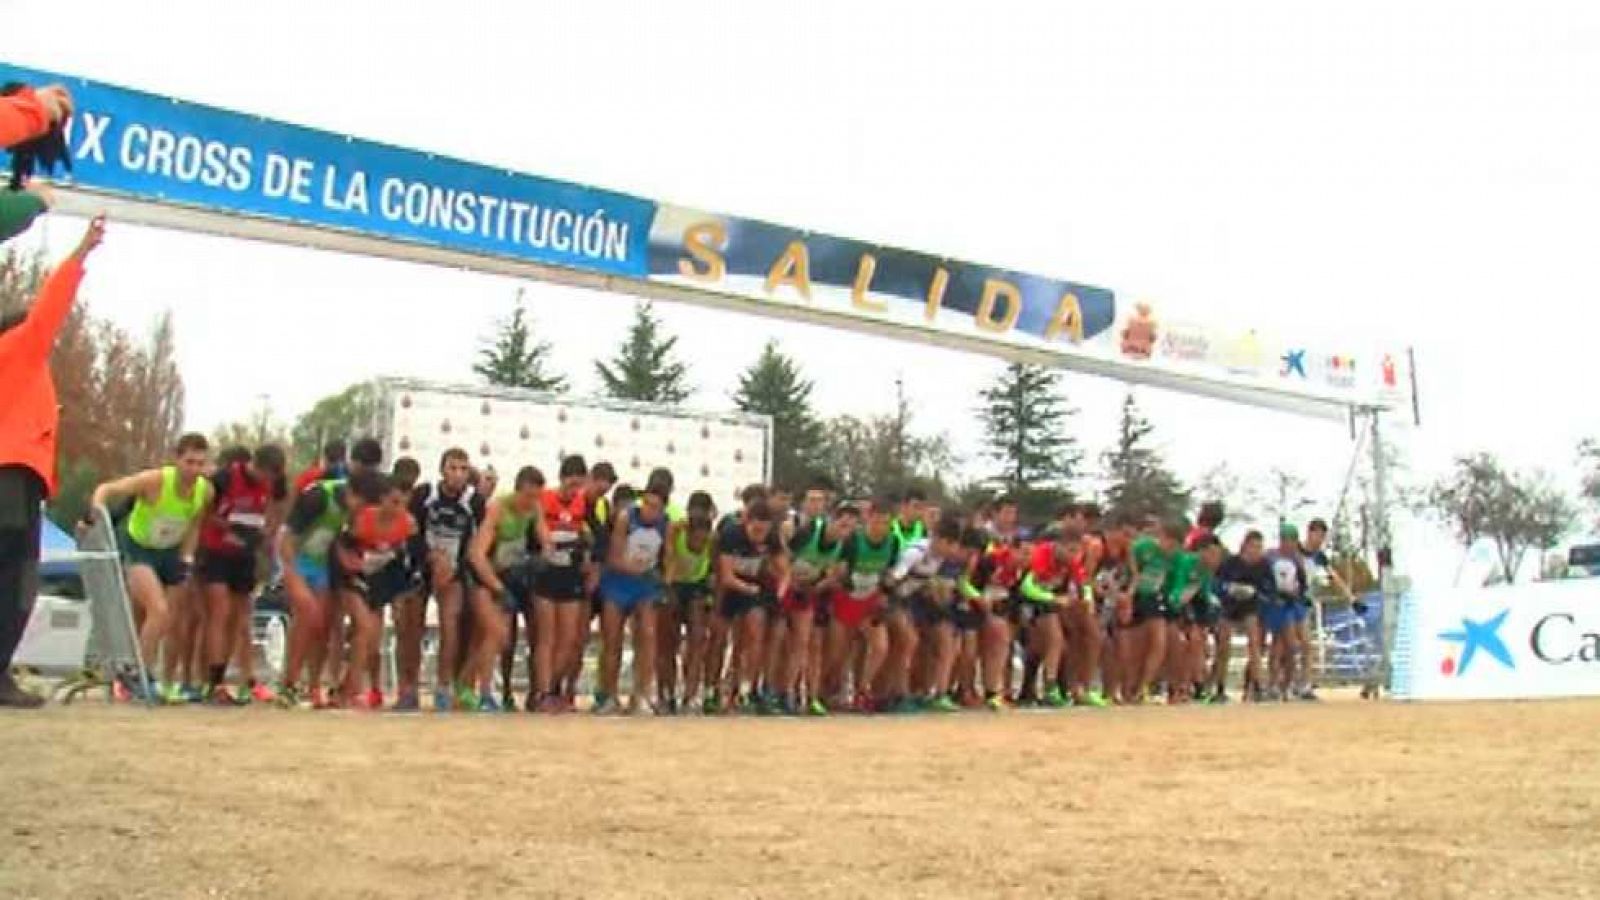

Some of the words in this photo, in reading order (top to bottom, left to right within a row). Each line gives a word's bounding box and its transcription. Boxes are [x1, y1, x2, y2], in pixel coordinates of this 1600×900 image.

[120, 123, 252, 191] CROSS
[262, 153, 314, 203] DE
[322, 163, 370, 216] LA
[379, 177, 630, 262] CONSTITUCIÓN
[679, 219, 1086, 345] SALIDA
[1529, 612, 1600, 665] Ca
